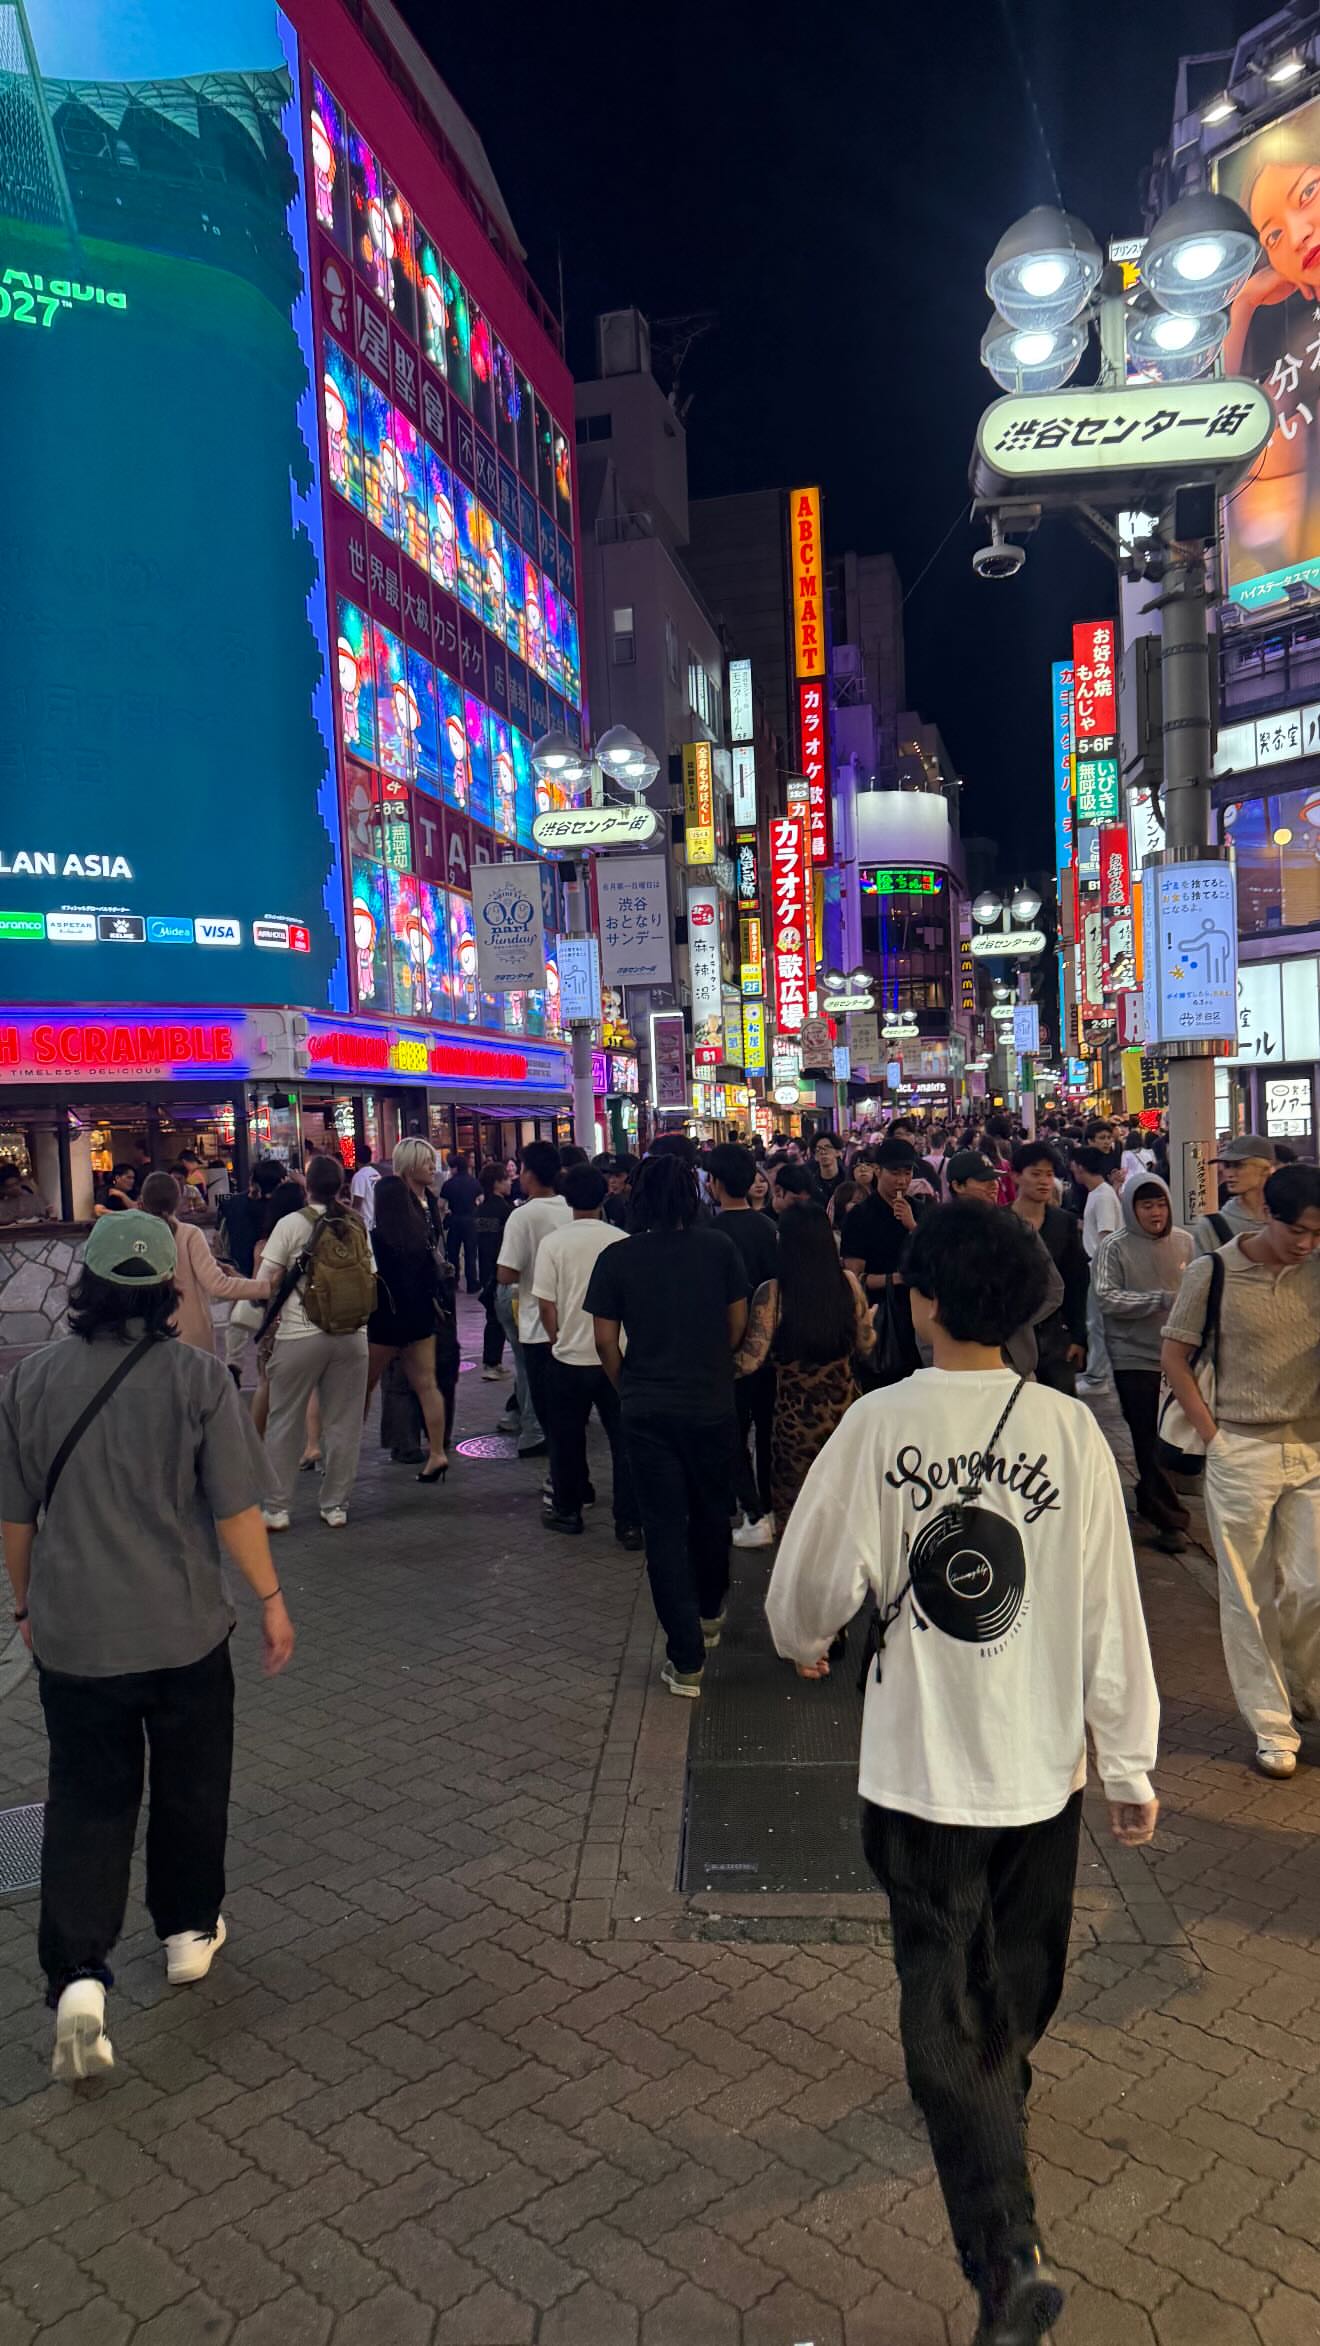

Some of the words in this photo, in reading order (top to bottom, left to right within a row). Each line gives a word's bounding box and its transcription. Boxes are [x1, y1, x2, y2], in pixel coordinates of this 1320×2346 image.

[994, 403, 1255, 452] 渋谷センター街
[797, 496, 818, 669] ABC-MART
[1093, 628, 1113, 697] お好み焼
[1076, 664, 1096, 731] もんじゃ
[1079, 763, 1096, 810] 無呼吸
[1097, 762, 1115, 809] いびき
[538, 814, 649, 837] 渋谷センター街
[62, 853, 133, 878] ASIA
[775, 821, 800, 925] カラオケ
[606, 914, 661, 929] おとなり
[619, 897, 648, 911] 渋谷
[160, 927, 190, 937] Midea
[202, 925, 235, 938] VISA
[484, 934, 537, 946] Sunday
[606, 931, 665, 947] サンデー
[745, 982, 759, 993] 2F
[778, 954, 804, 1028] 歌広場
[33, 1025, 233, 1063] SCRAMBLE
[885, 1445, 1061, 1523] Serenity
